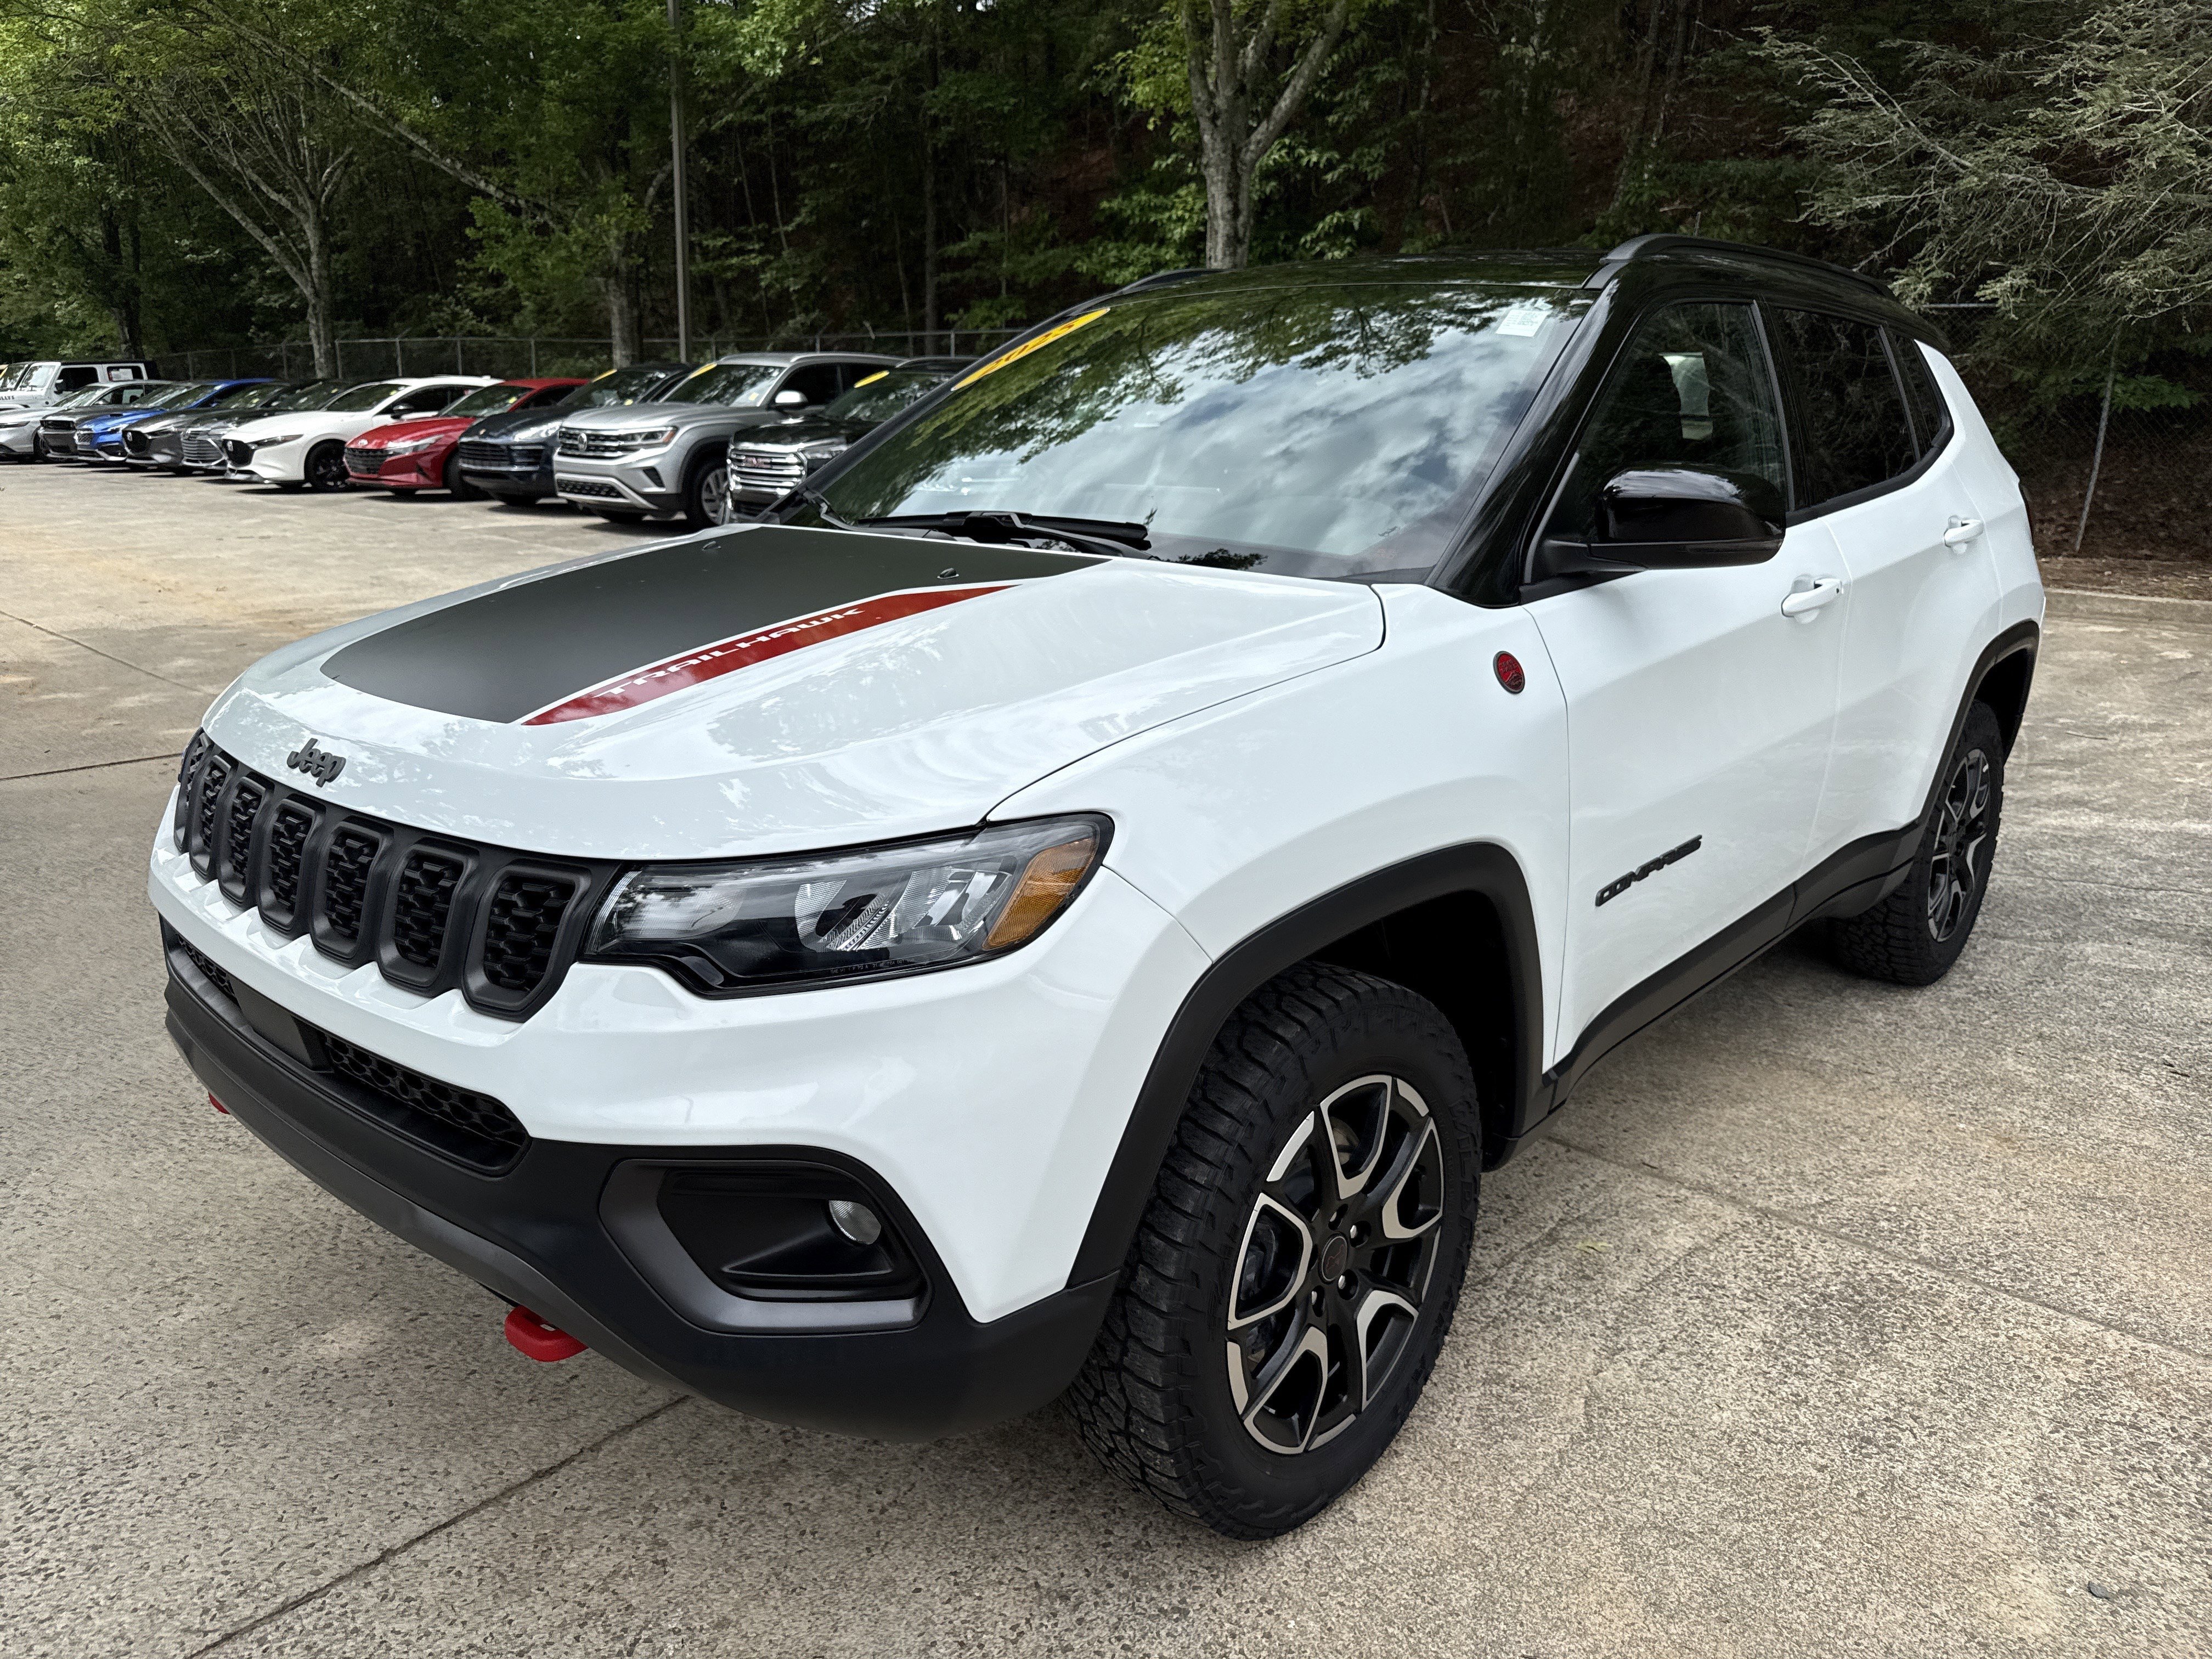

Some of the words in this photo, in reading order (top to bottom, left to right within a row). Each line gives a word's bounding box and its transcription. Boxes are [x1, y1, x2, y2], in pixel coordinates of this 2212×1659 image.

[979, 318, 1077, 377] 2025
[592, 608, 866, 698] TRAILHAWK
[286, 737, 347, 788] Jeep
[1595, 834, 1702, 907] COMPASS
